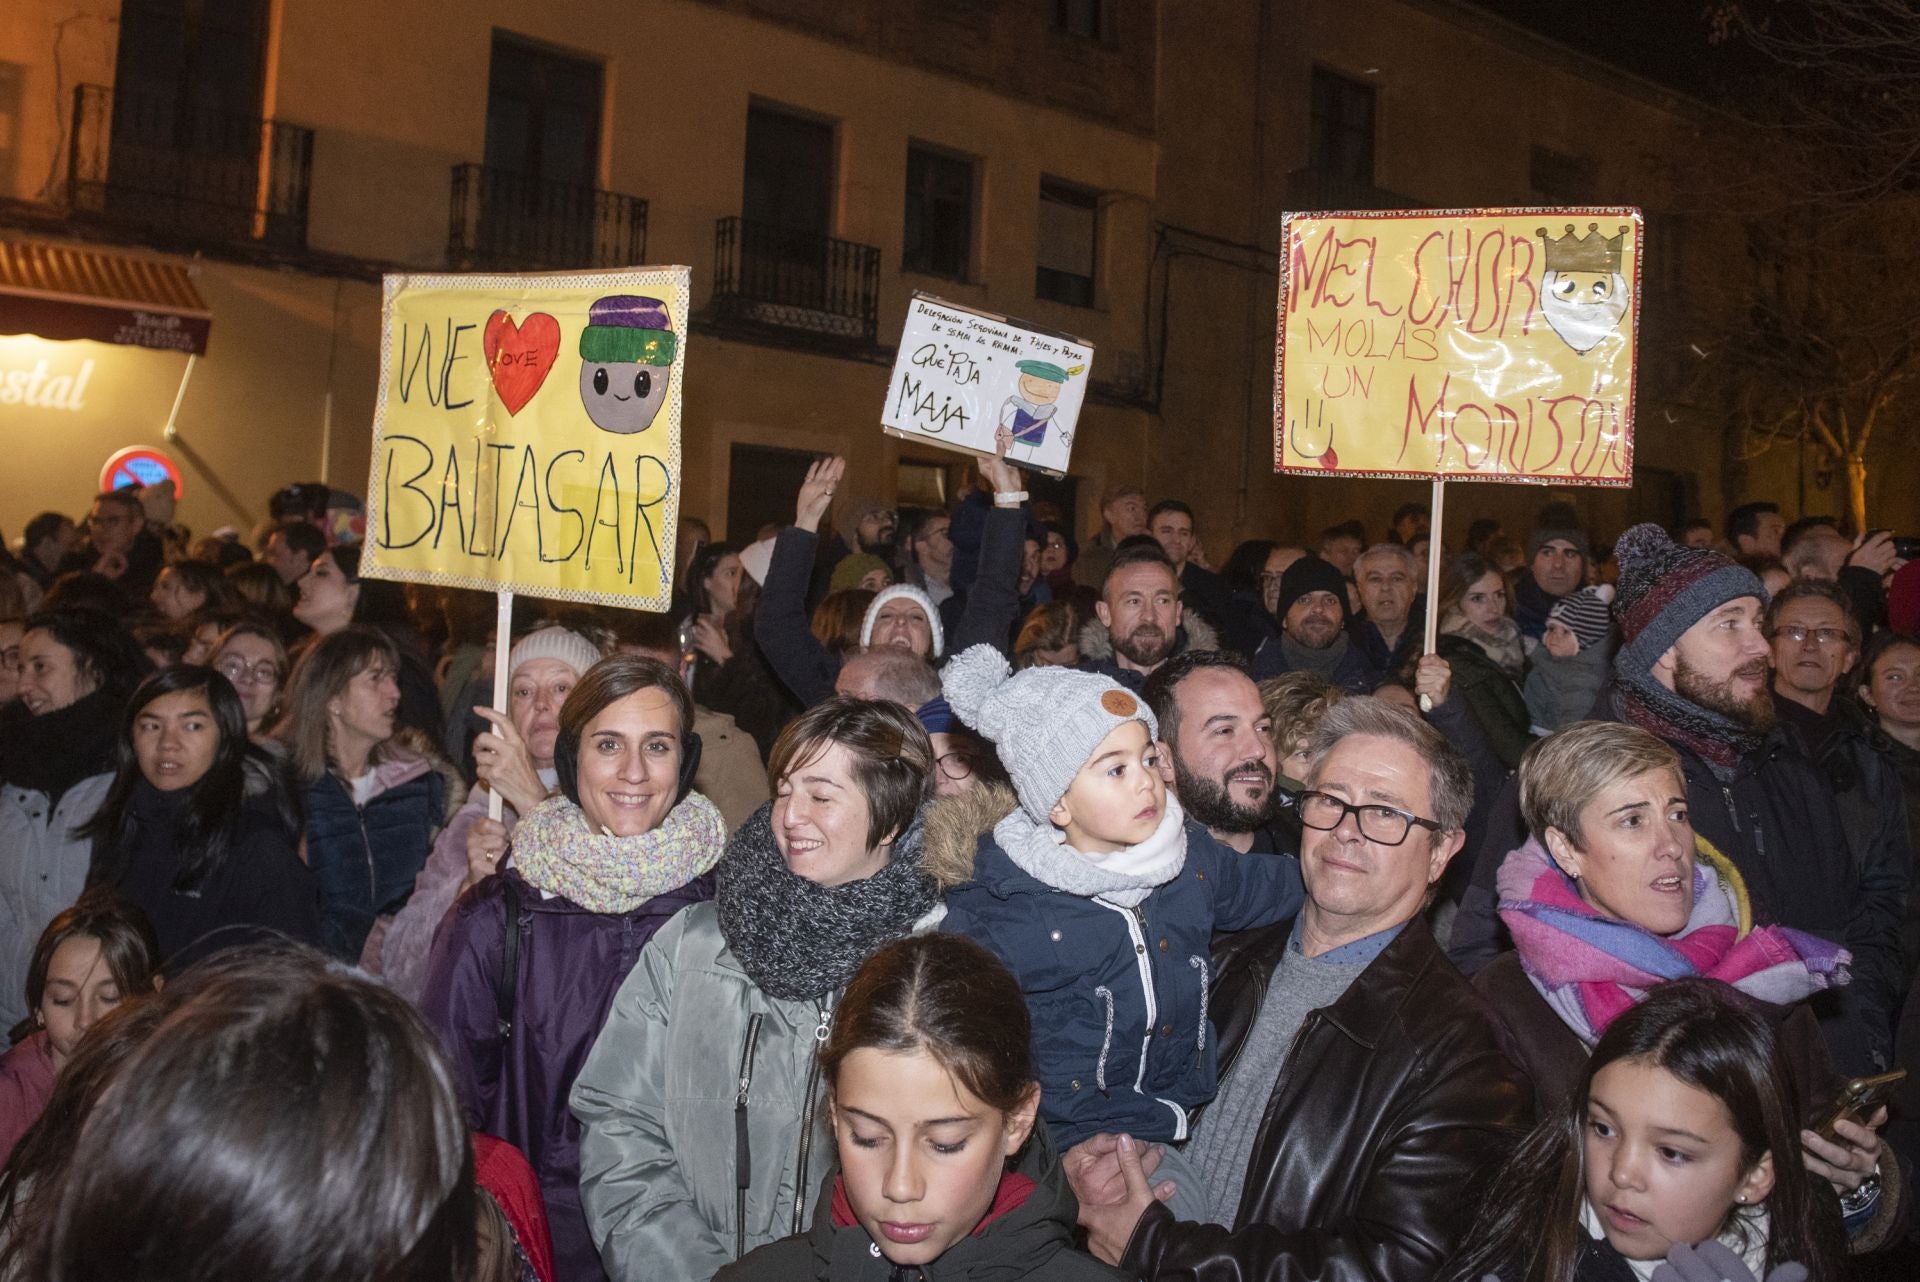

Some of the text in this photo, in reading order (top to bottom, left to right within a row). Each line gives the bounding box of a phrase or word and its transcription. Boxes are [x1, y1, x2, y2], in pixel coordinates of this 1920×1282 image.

[400, 317, 477, 410] WE
[911, 343, 945, 369] QUE
[1306, 318, 1440, 362] MOLAS
[0, 359, 95, 411] stal
[895, 371, 971, 433] MAJA
[1322, 365, 1376, 400] UN
[376, 434, 672, 584] BALTASAR
